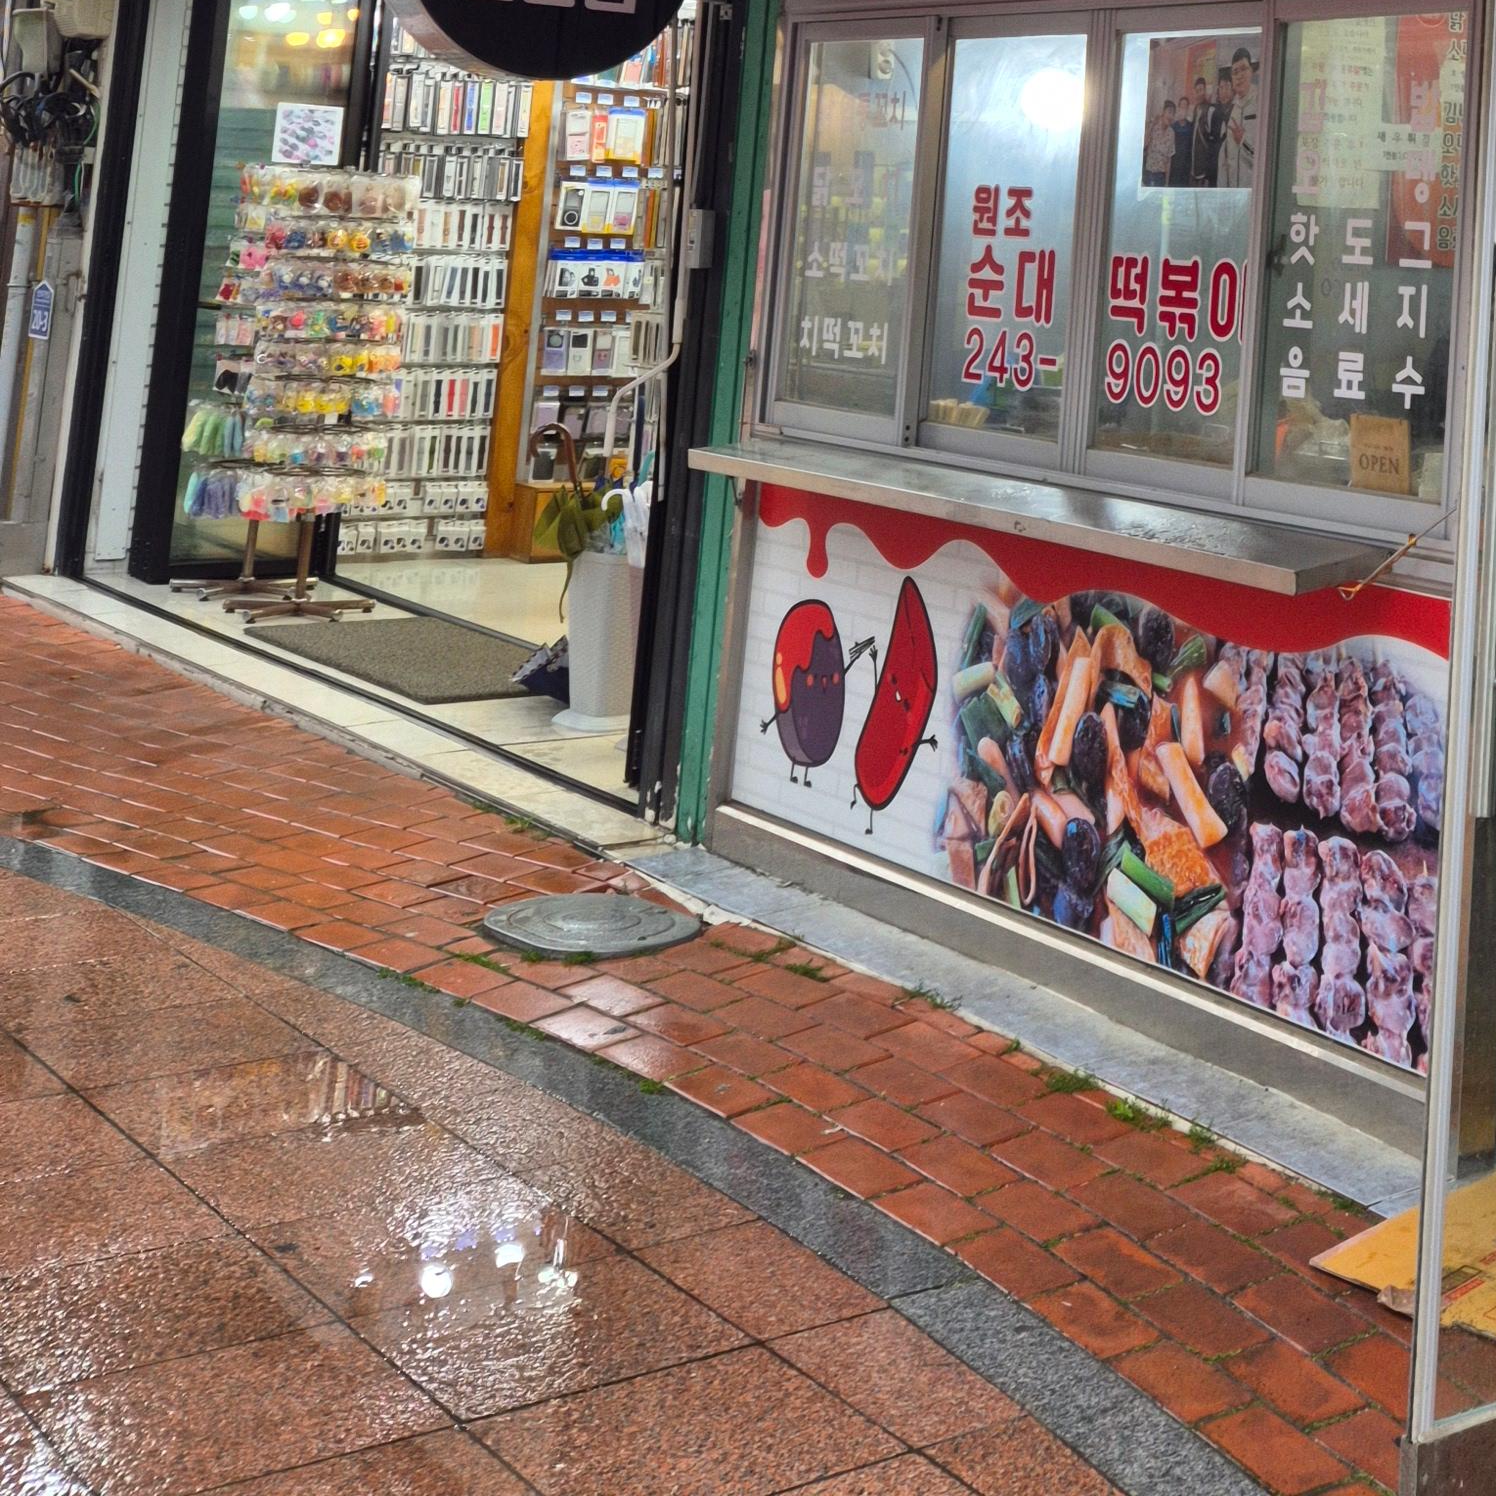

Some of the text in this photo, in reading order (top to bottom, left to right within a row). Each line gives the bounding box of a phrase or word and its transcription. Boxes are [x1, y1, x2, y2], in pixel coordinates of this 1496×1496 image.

[970, 184, 1033, 239] 원조
[1288, 210, 1433, 270] 핫도그
[965, 243, 1057, 326] 순대
[1107, 253, 1247, 342] 떡볶이
[1283, 279, 1428, 340] 소세지
[800, 314, 888, 364] 치떡꼬치
[962, 327, 1060, 392] 243-
[1104, 337, 1222, 416] 9093
[1280, 351, 1427, 411] 음료수
[1360, 454, 1400, 475] OPEN
